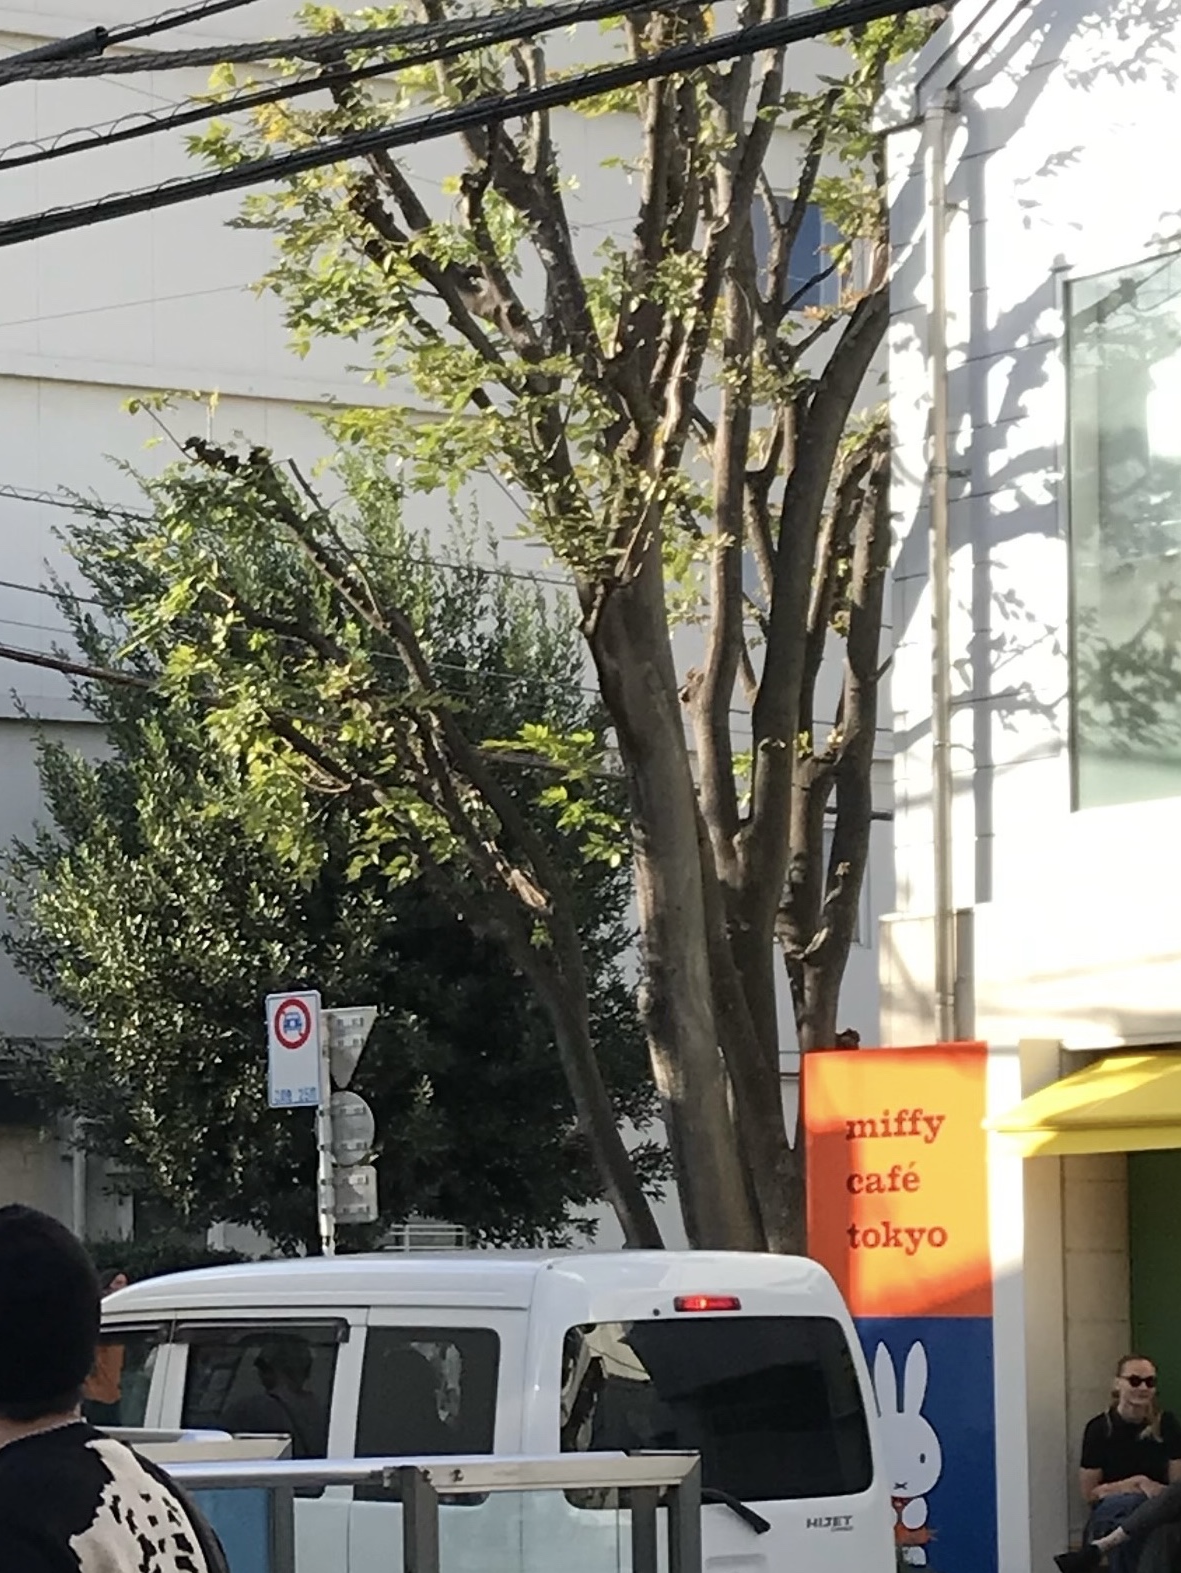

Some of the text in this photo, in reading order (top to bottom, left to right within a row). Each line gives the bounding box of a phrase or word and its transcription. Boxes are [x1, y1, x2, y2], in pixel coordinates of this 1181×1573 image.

[846, 1109, 946, 1147] miffy
[846, 1162, 921, 1194] café
[846, 1220, 948, 1256] tokyo
[806, 1515, 853, 1528] HIJET
